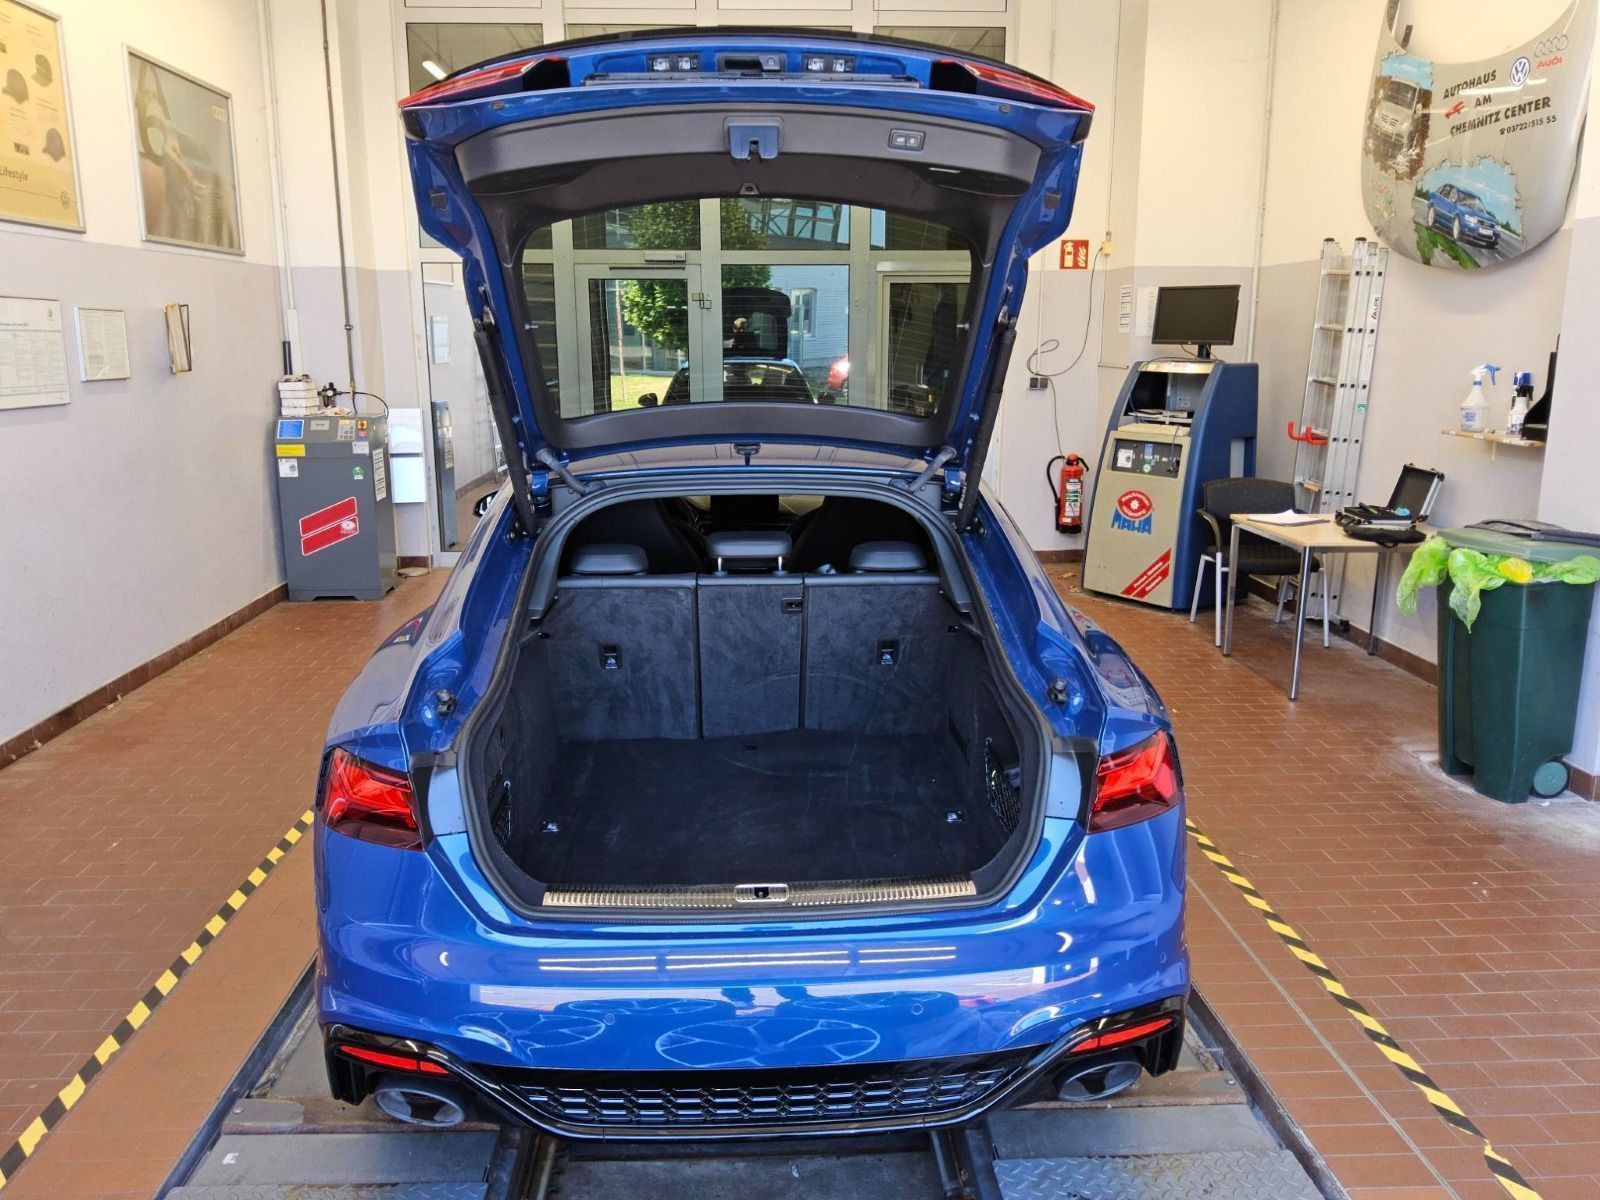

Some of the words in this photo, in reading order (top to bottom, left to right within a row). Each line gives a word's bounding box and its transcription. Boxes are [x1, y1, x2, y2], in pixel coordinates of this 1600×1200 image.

[1536, 56, 1563, 69] Audi
[1443, 69, 1497, 99] AUTOHAUS
[1474, 94, 1492, 108] AM
[1450, 110, 1502, 136] CHEMNITZ
[1504, 97, 1551, 120] CENTER
[1506, 118, 1543, 134] 03722/515
[1546, 115, 1557, 124] 55
